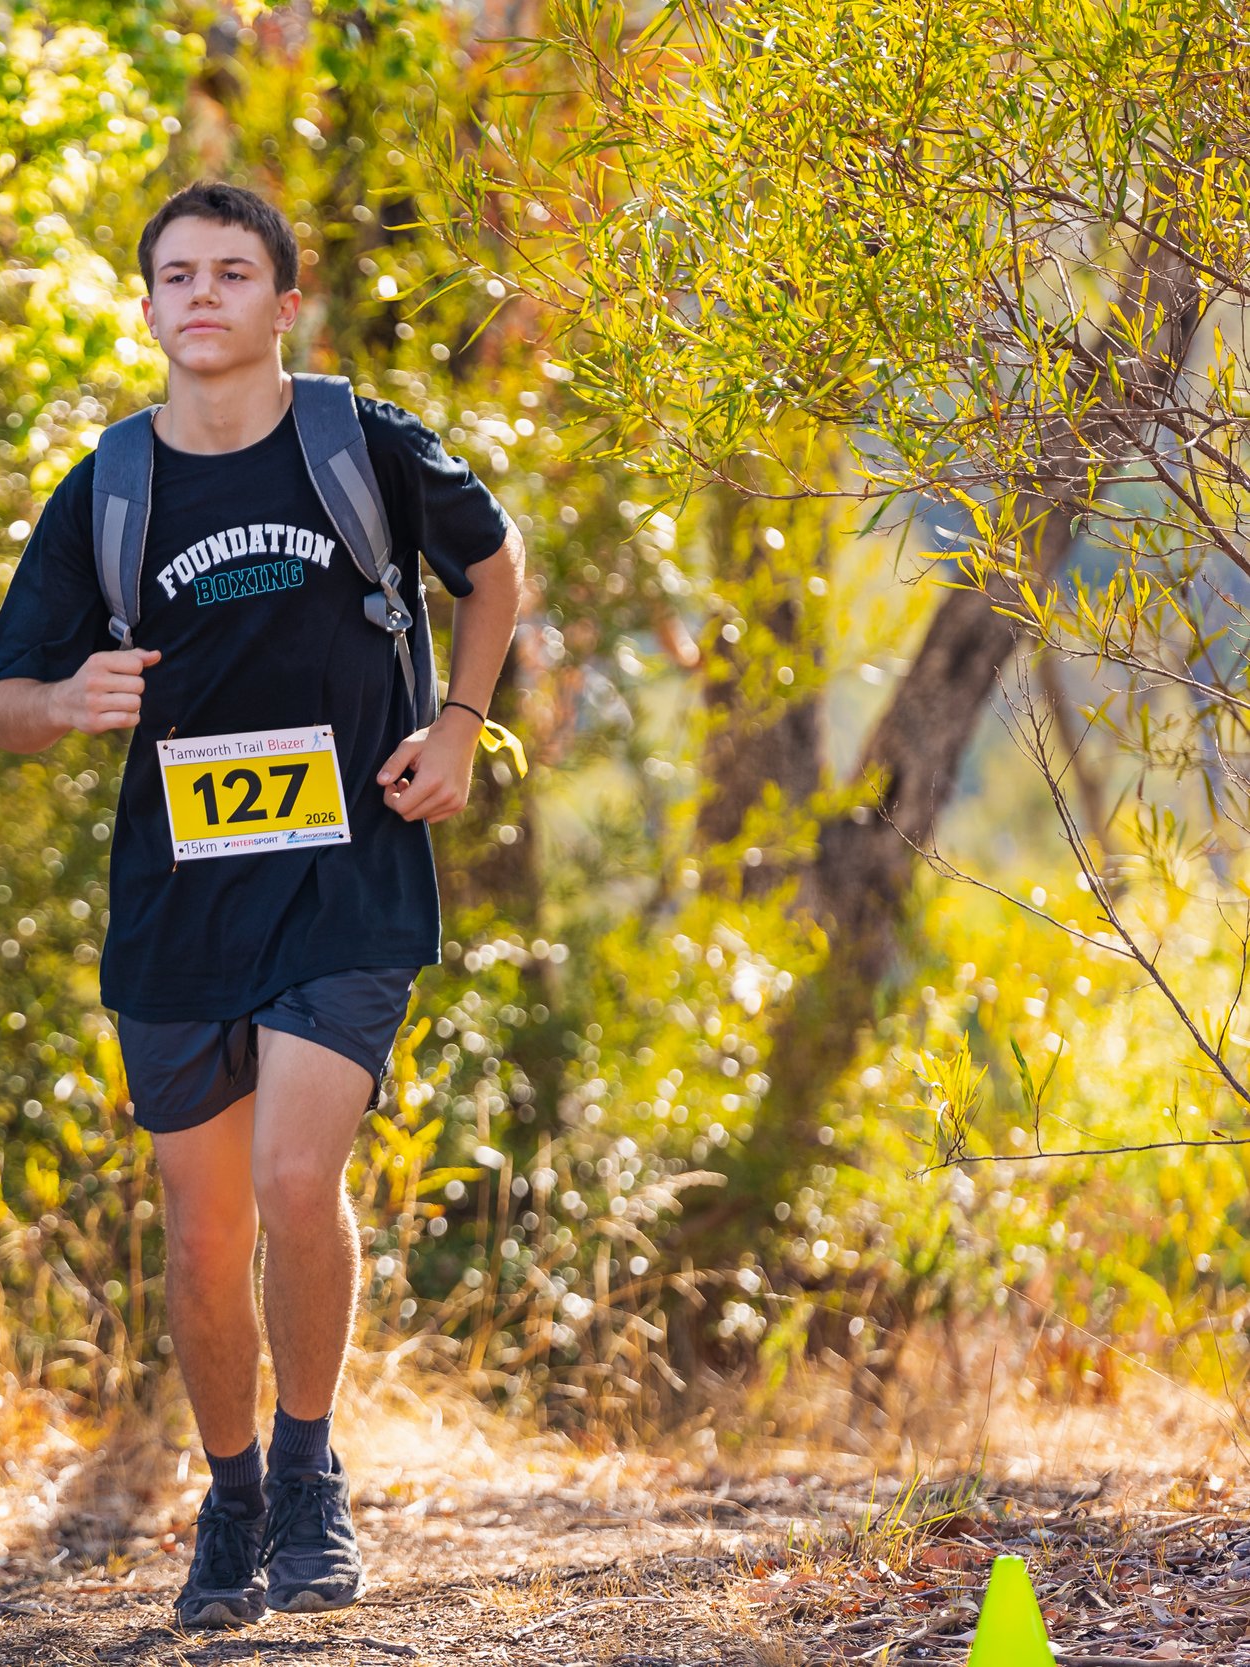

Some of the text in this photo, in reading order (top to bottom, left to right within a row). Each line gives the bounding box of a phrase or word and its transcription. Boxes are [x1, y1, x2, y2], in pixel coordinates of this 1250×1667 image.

[156, 523, 336, 601] FOUNDATION
[194, 559, 304, 606] BOXING
[169, 738, 305, 760] Tamworth Trail Blazer
[193, 763, 309, 826] 127
[305, 811, 336, 825] 2026
[184, 841, 218, 855] 15km
[230, 836, 279, 848] INTERSPORT
